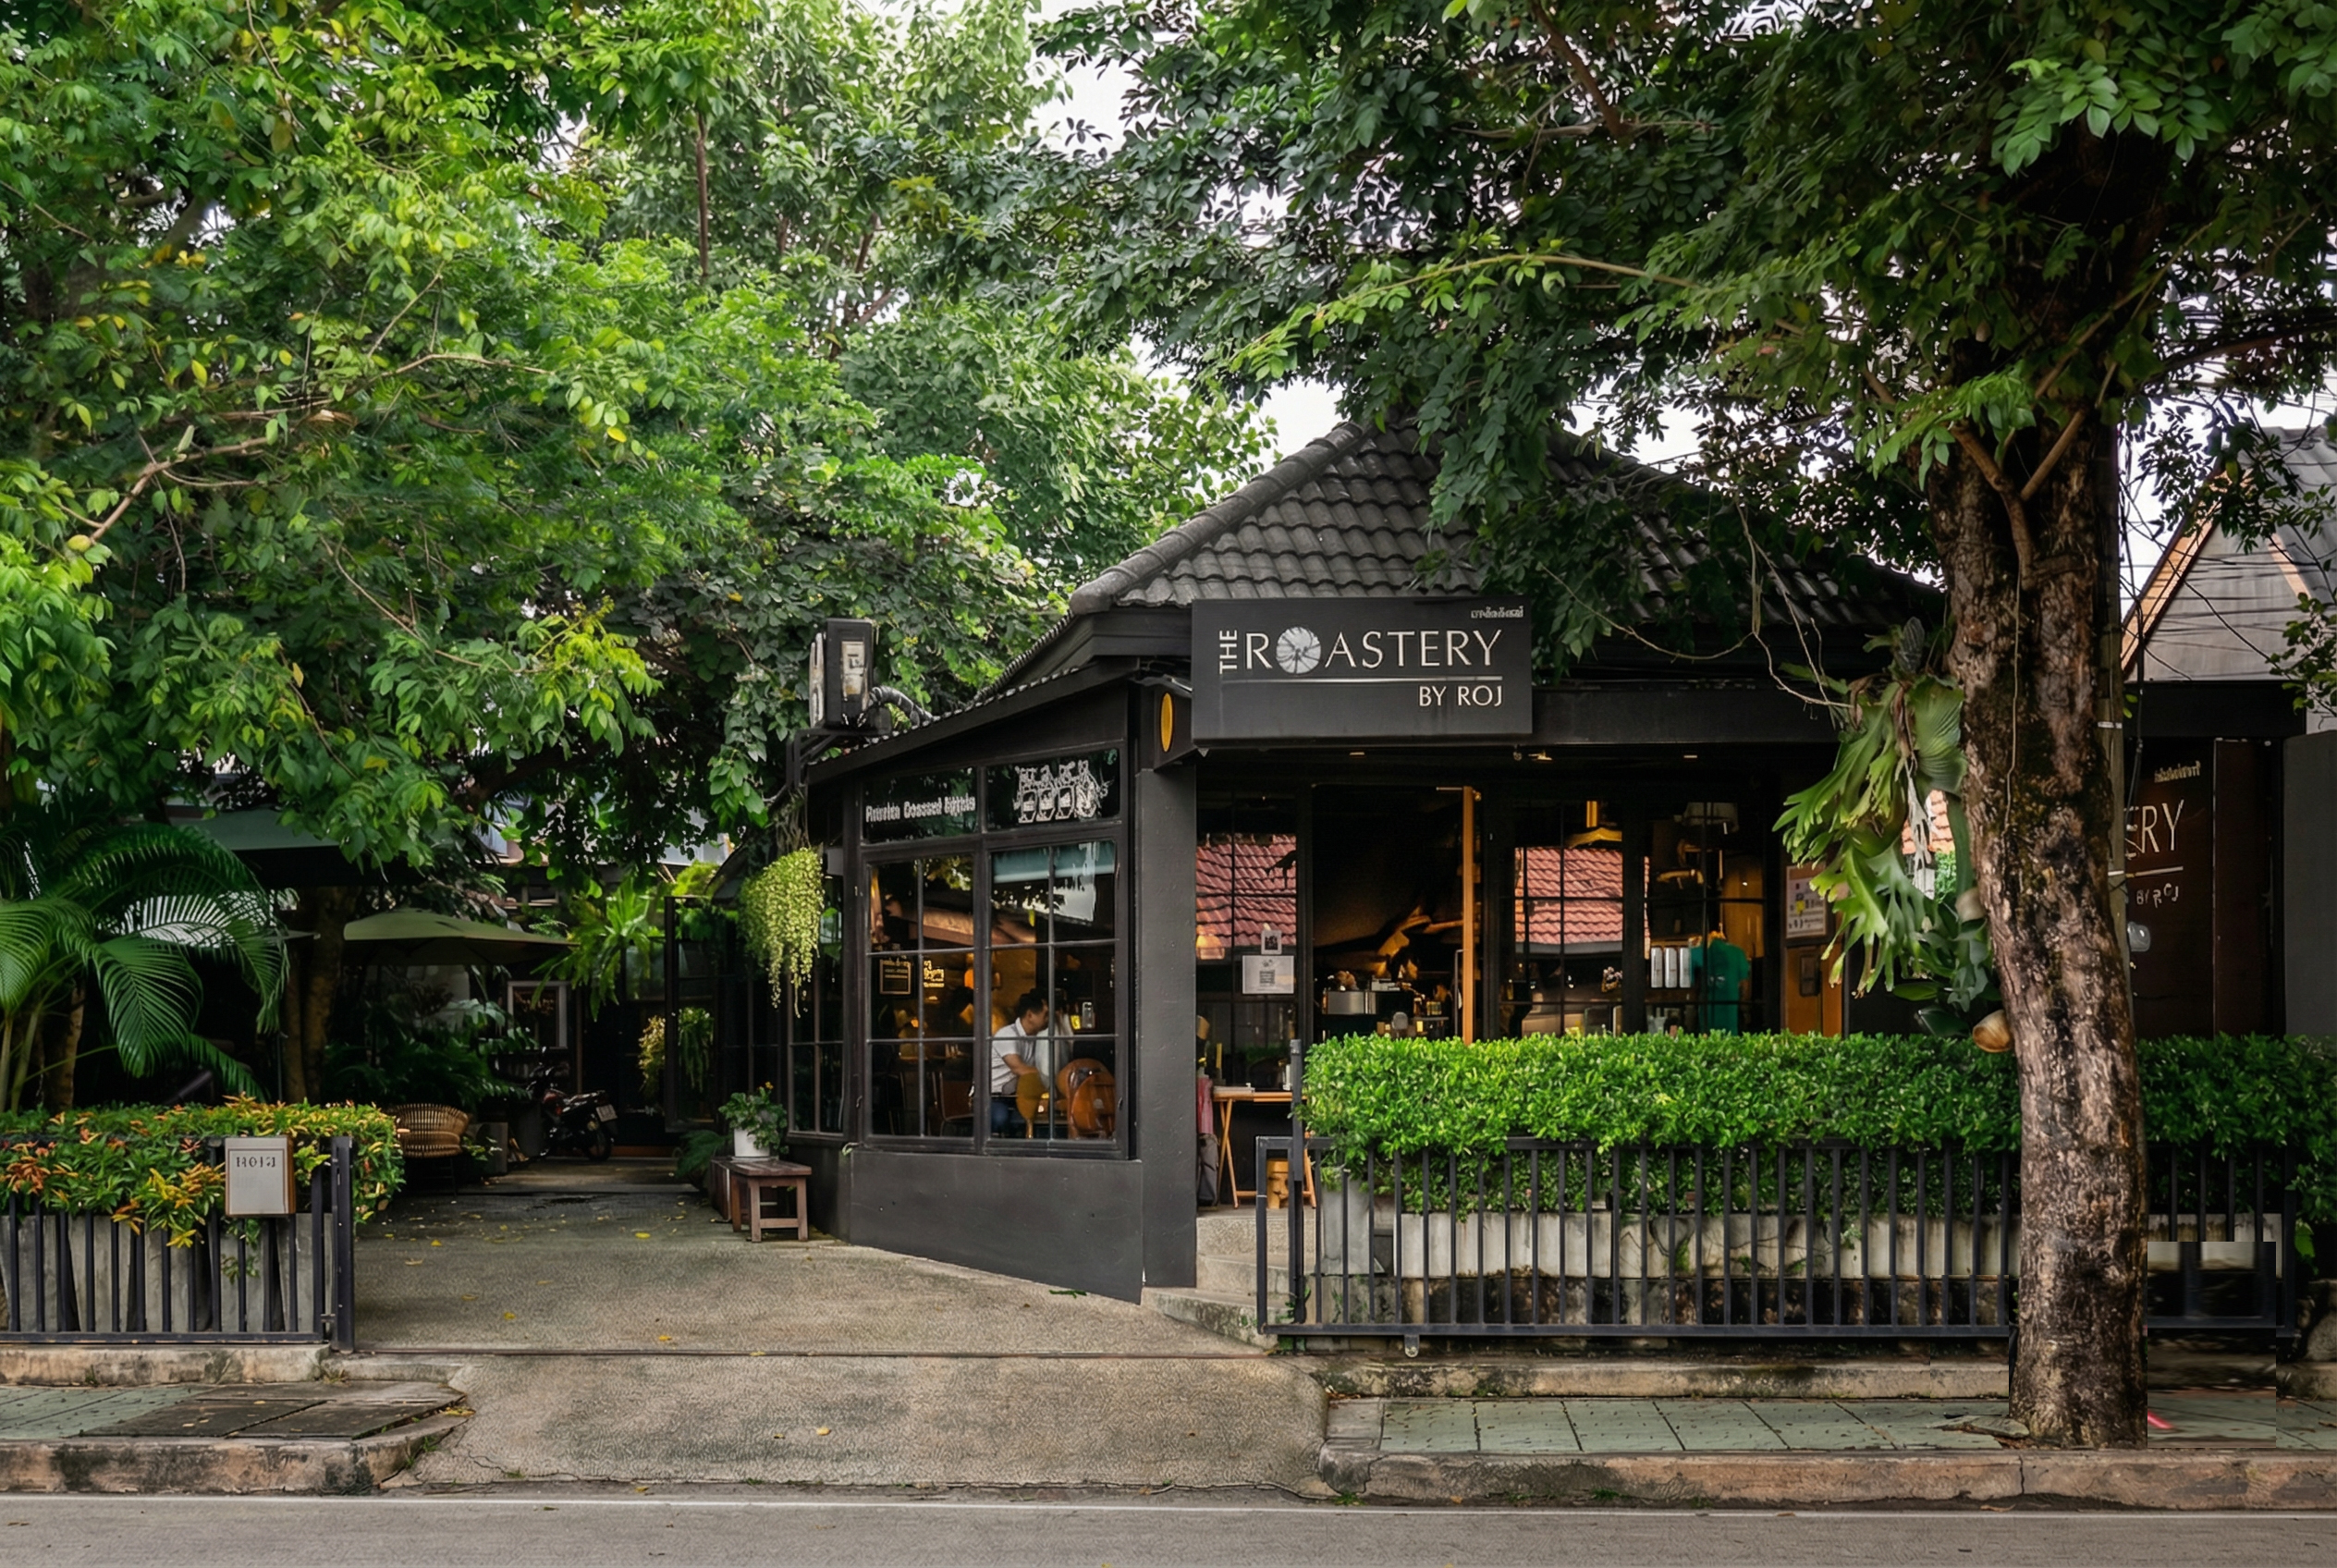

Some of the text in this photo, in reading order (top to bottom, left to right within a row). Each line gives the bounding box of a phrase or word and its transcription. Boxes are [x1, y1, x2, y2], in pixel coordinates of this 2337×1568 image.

[1218, 630, 1238, 675] THE
[1245, 626, 1502, 674] ROASTERY
[1419, 685, 1502, 707] BY ROJ
